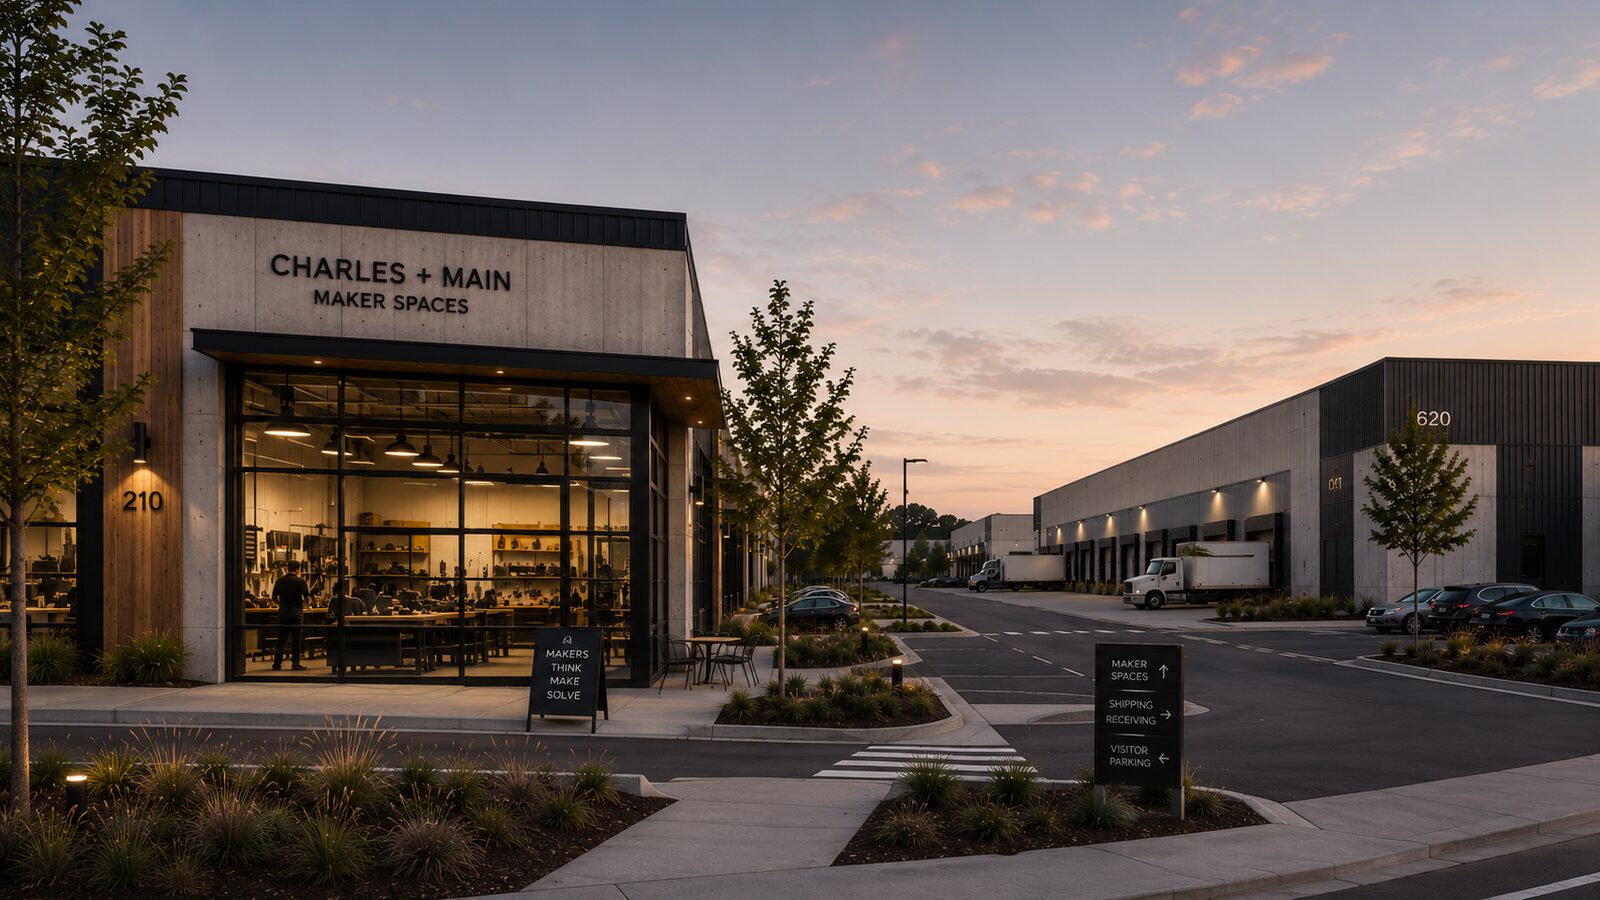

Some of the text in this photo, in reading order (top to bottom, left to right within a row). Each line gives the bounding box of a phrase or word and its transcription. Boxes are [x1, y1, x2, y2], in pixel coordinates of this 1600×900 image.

[270, 253, 511, 292] CHARLES + MAIN
[313, 289, 469, 314] MAKER SPACES
[1416, 410, 1451, 427] 620
[123, 490, 164, 512] 210
[545, 649, 589, 659] MAKERS
[551, 662, 582, 673] THINK
[1111, 659, 1148, 669] MAKER
[549, 676, 580, 686] MAKE
[1110, 671, 1149, 681] SPACES
[546, 690, 581, 700] SOLVE
[1108, 699, 1154, 710] SHIPPING
[1105, 714, 1157, 725] RECEIVING
[1110, 744, 1149, 755] VISITOR
[1109, 756, 1152, 768] PARKING
